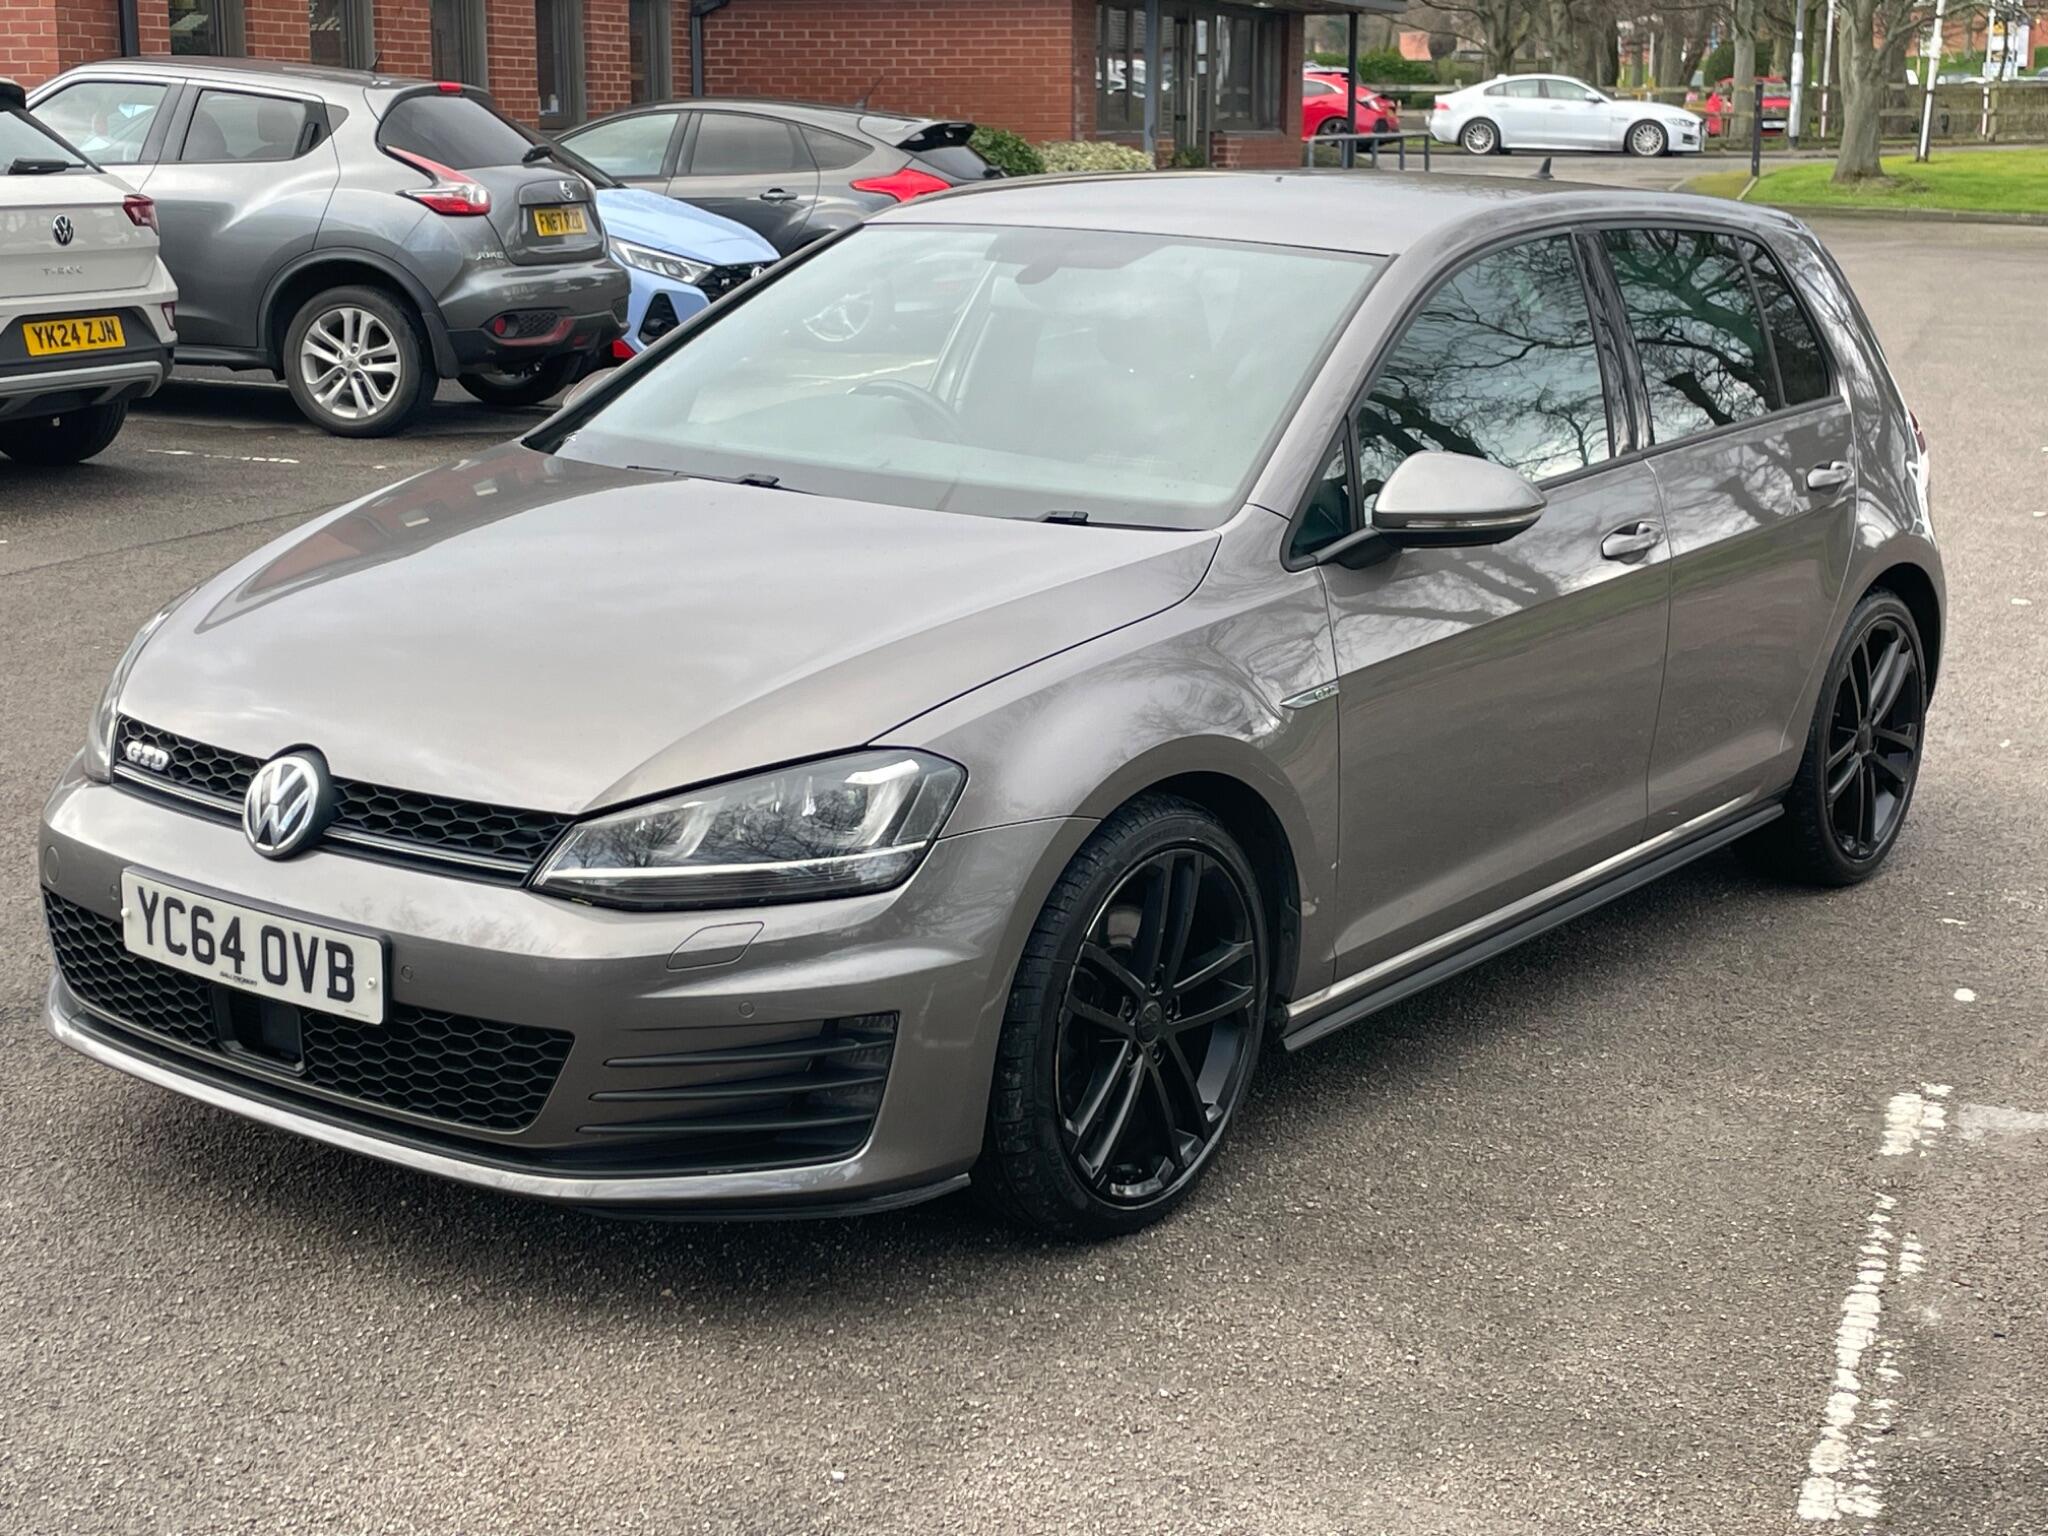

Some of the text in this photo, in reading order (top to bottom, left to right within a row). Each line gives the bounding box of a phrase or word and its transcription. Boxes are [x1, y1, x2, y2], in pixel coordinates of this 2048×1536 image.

[32, 320, 119, 350] YK24 ZJN
[126, 741, 169, 771] GTD
[137, 885, 355, 1004] YC64 OVB
